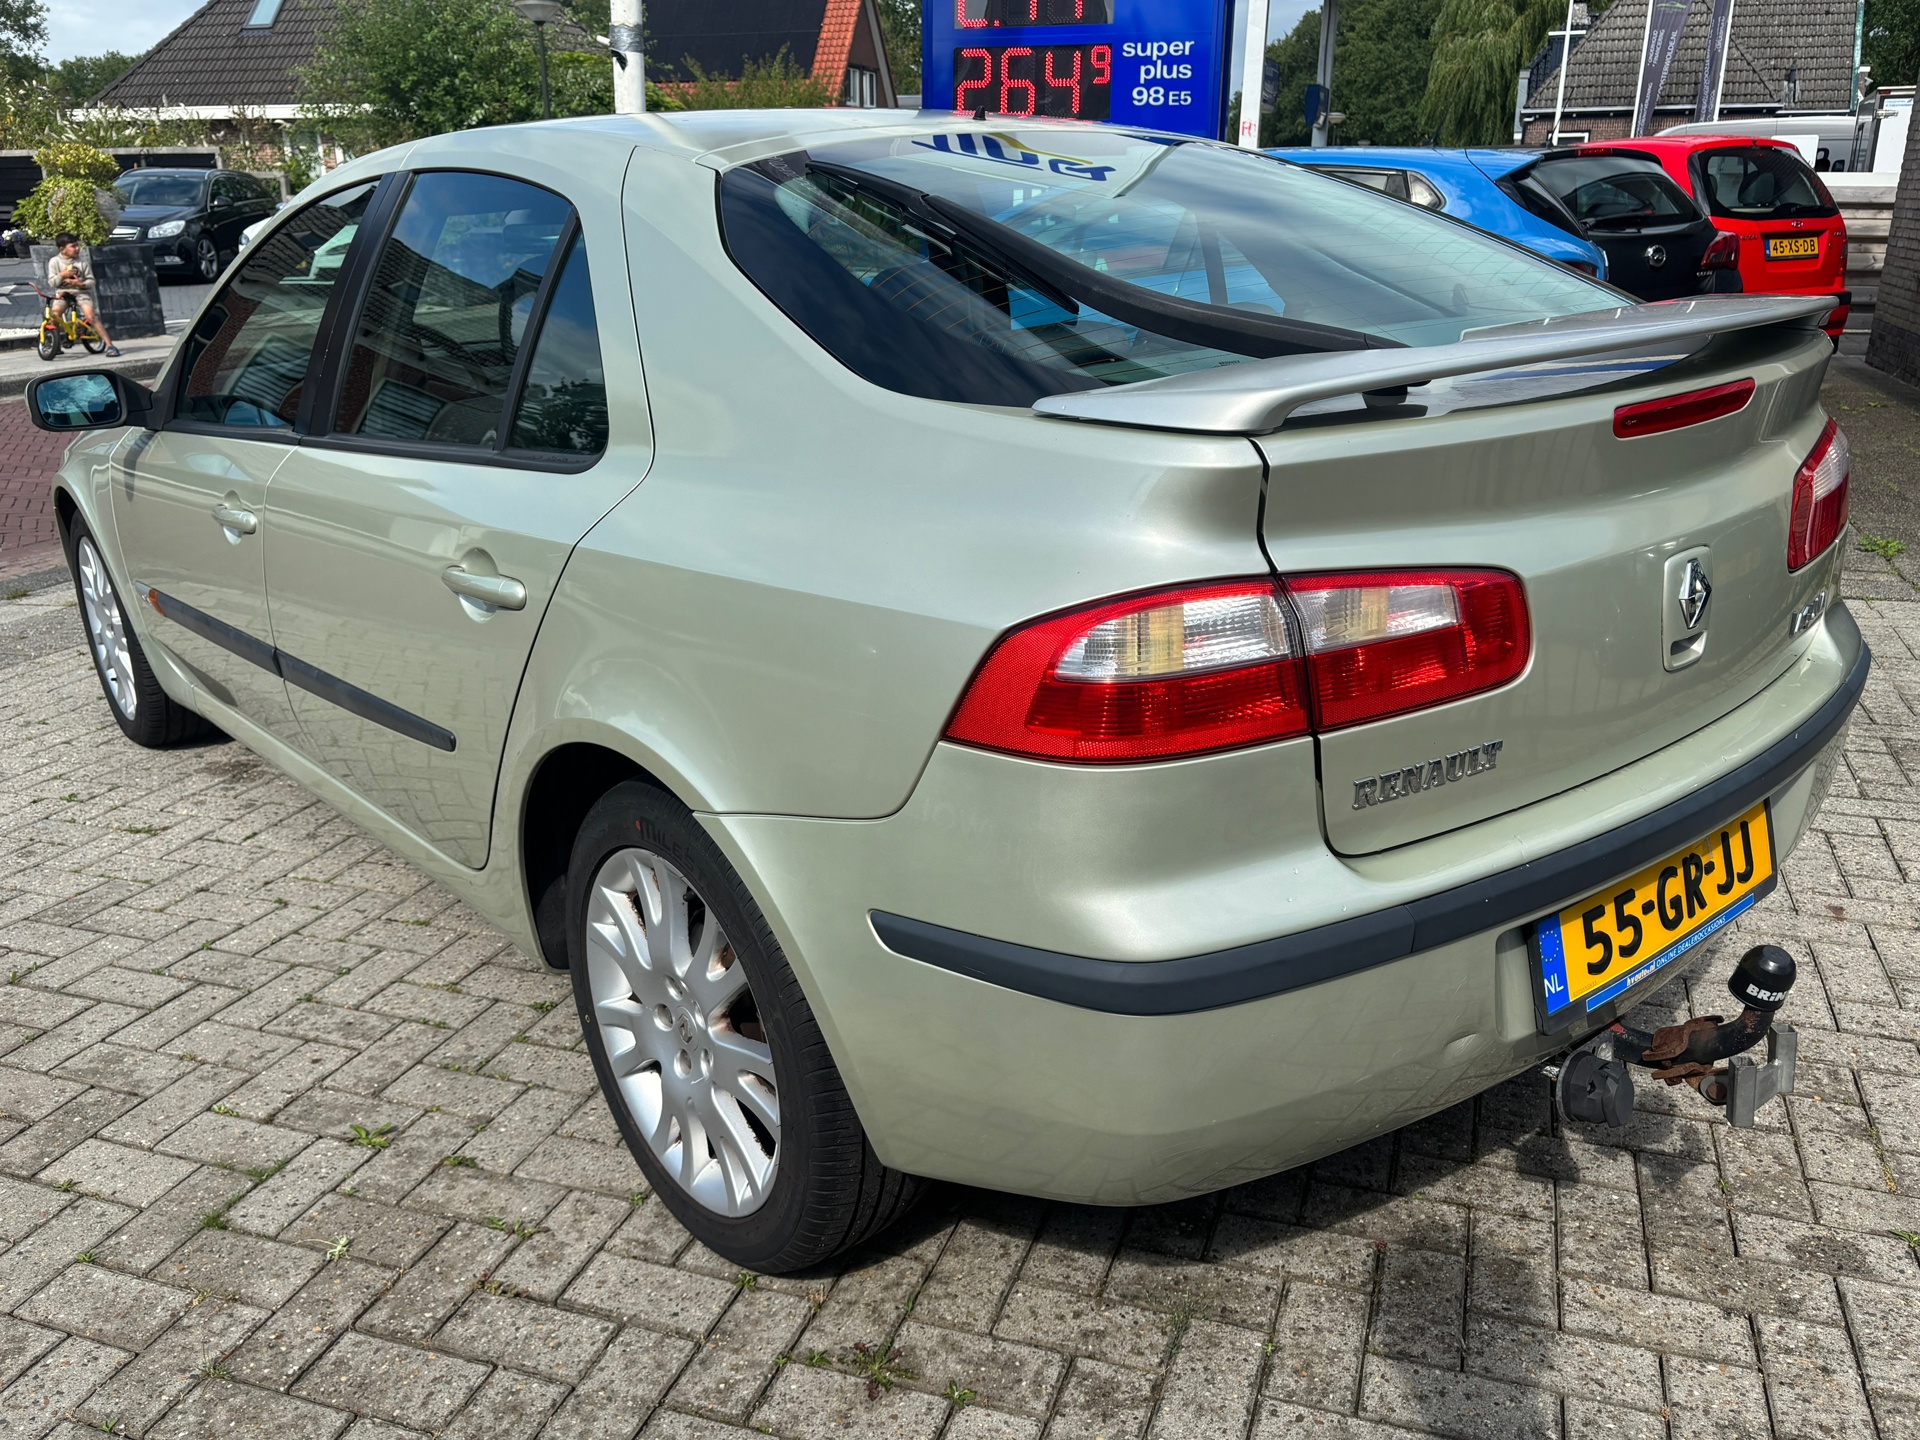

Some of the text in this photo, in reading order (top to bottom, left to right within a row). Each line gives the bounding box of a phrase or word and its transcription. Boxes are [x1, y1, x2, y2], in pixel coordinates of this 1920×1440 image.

[1122, 41, 1194, 61] super
[1139, 61, 1192, 83] plus
[1132, 87, 1191, 106] 98 E5
[1352, 739, 1503, 810] RENAULT
[1582, 820, 1754, 976] 55-GR-JJ
[1656, 948, 1677, 967] ONLINE
[1544, 973, 1564, 998] NL
